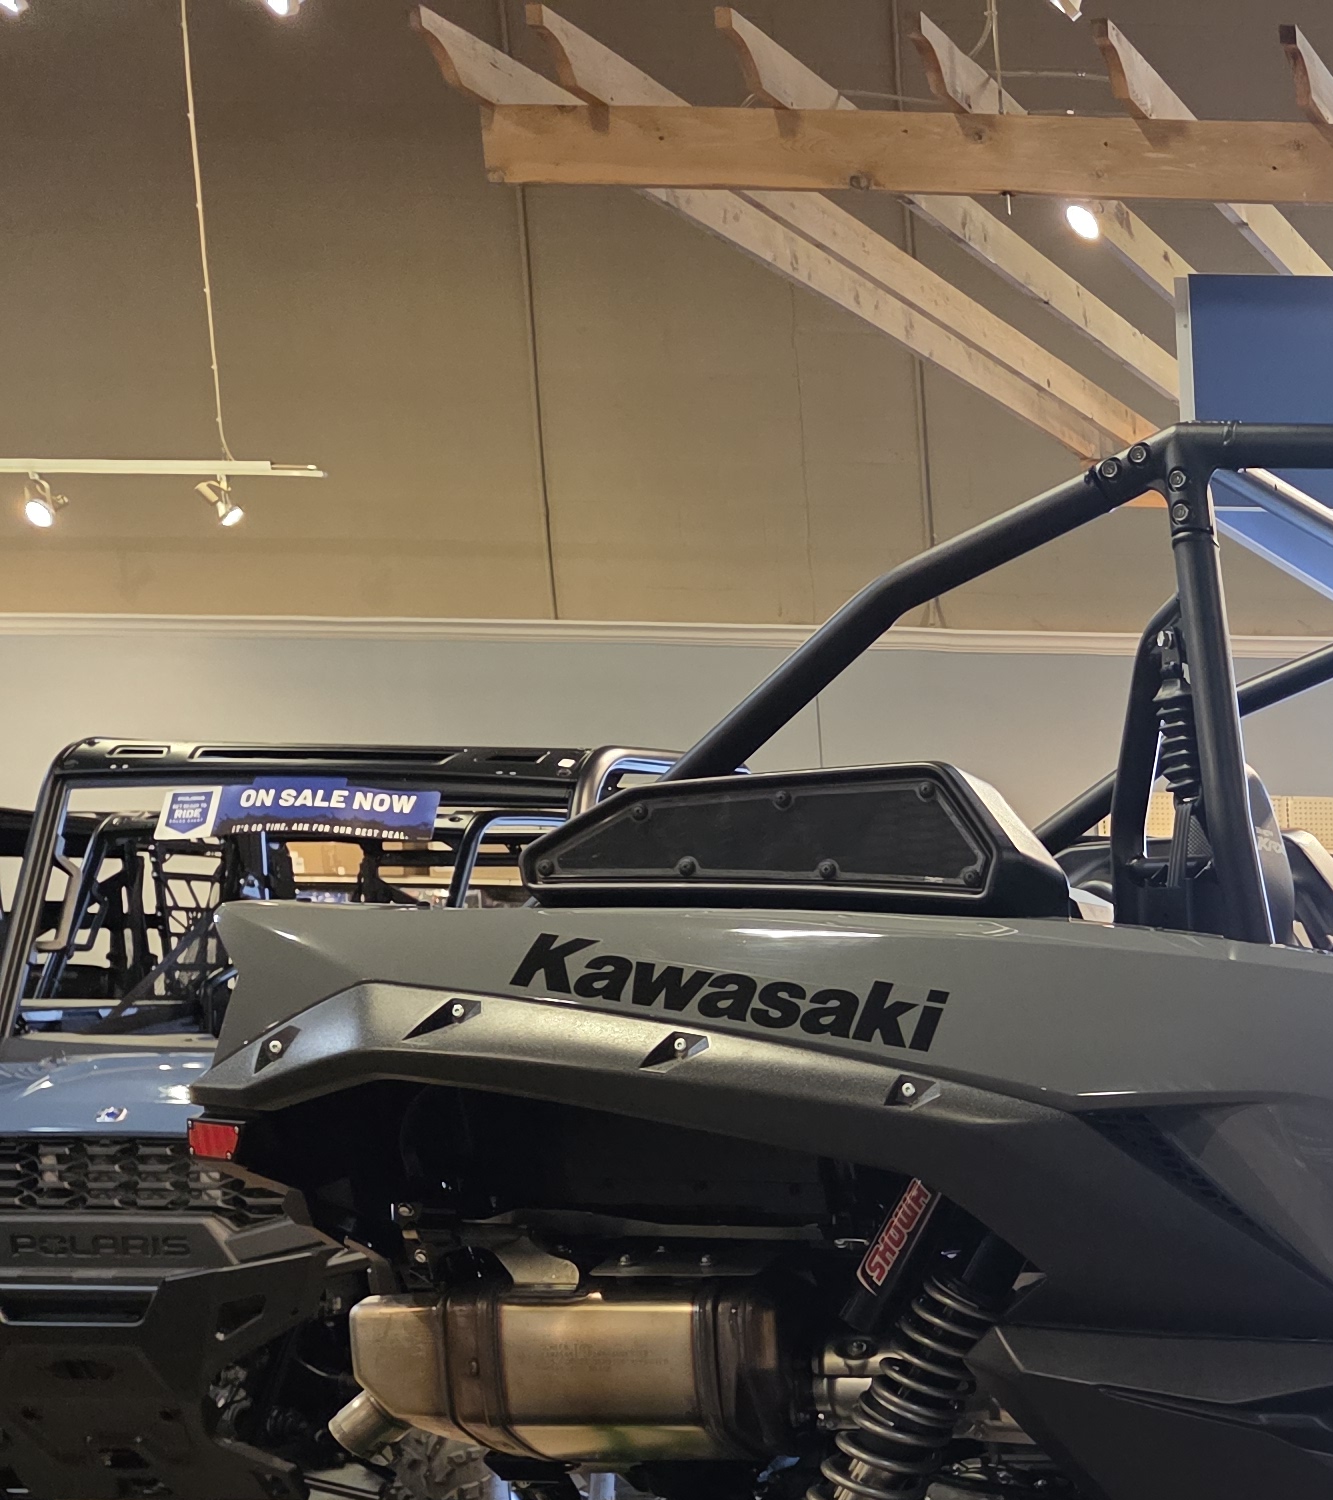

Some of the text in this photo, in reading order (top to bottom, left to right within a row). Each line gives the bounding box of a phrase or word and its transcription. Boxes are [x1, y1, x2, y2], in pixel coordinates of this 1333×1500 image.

[240, 788, 417, 813] ON SALE NOW
[312, 823, 330, 832] FOR
[333, 825, 352, 834] OUR
[355, 827, 379, 836] BEST
[509, 932, 950, 1053] Kawasaki
[864, 1177, 932, 1287] SHOWA
[9, 1234, 191, 1257] POLARIS
